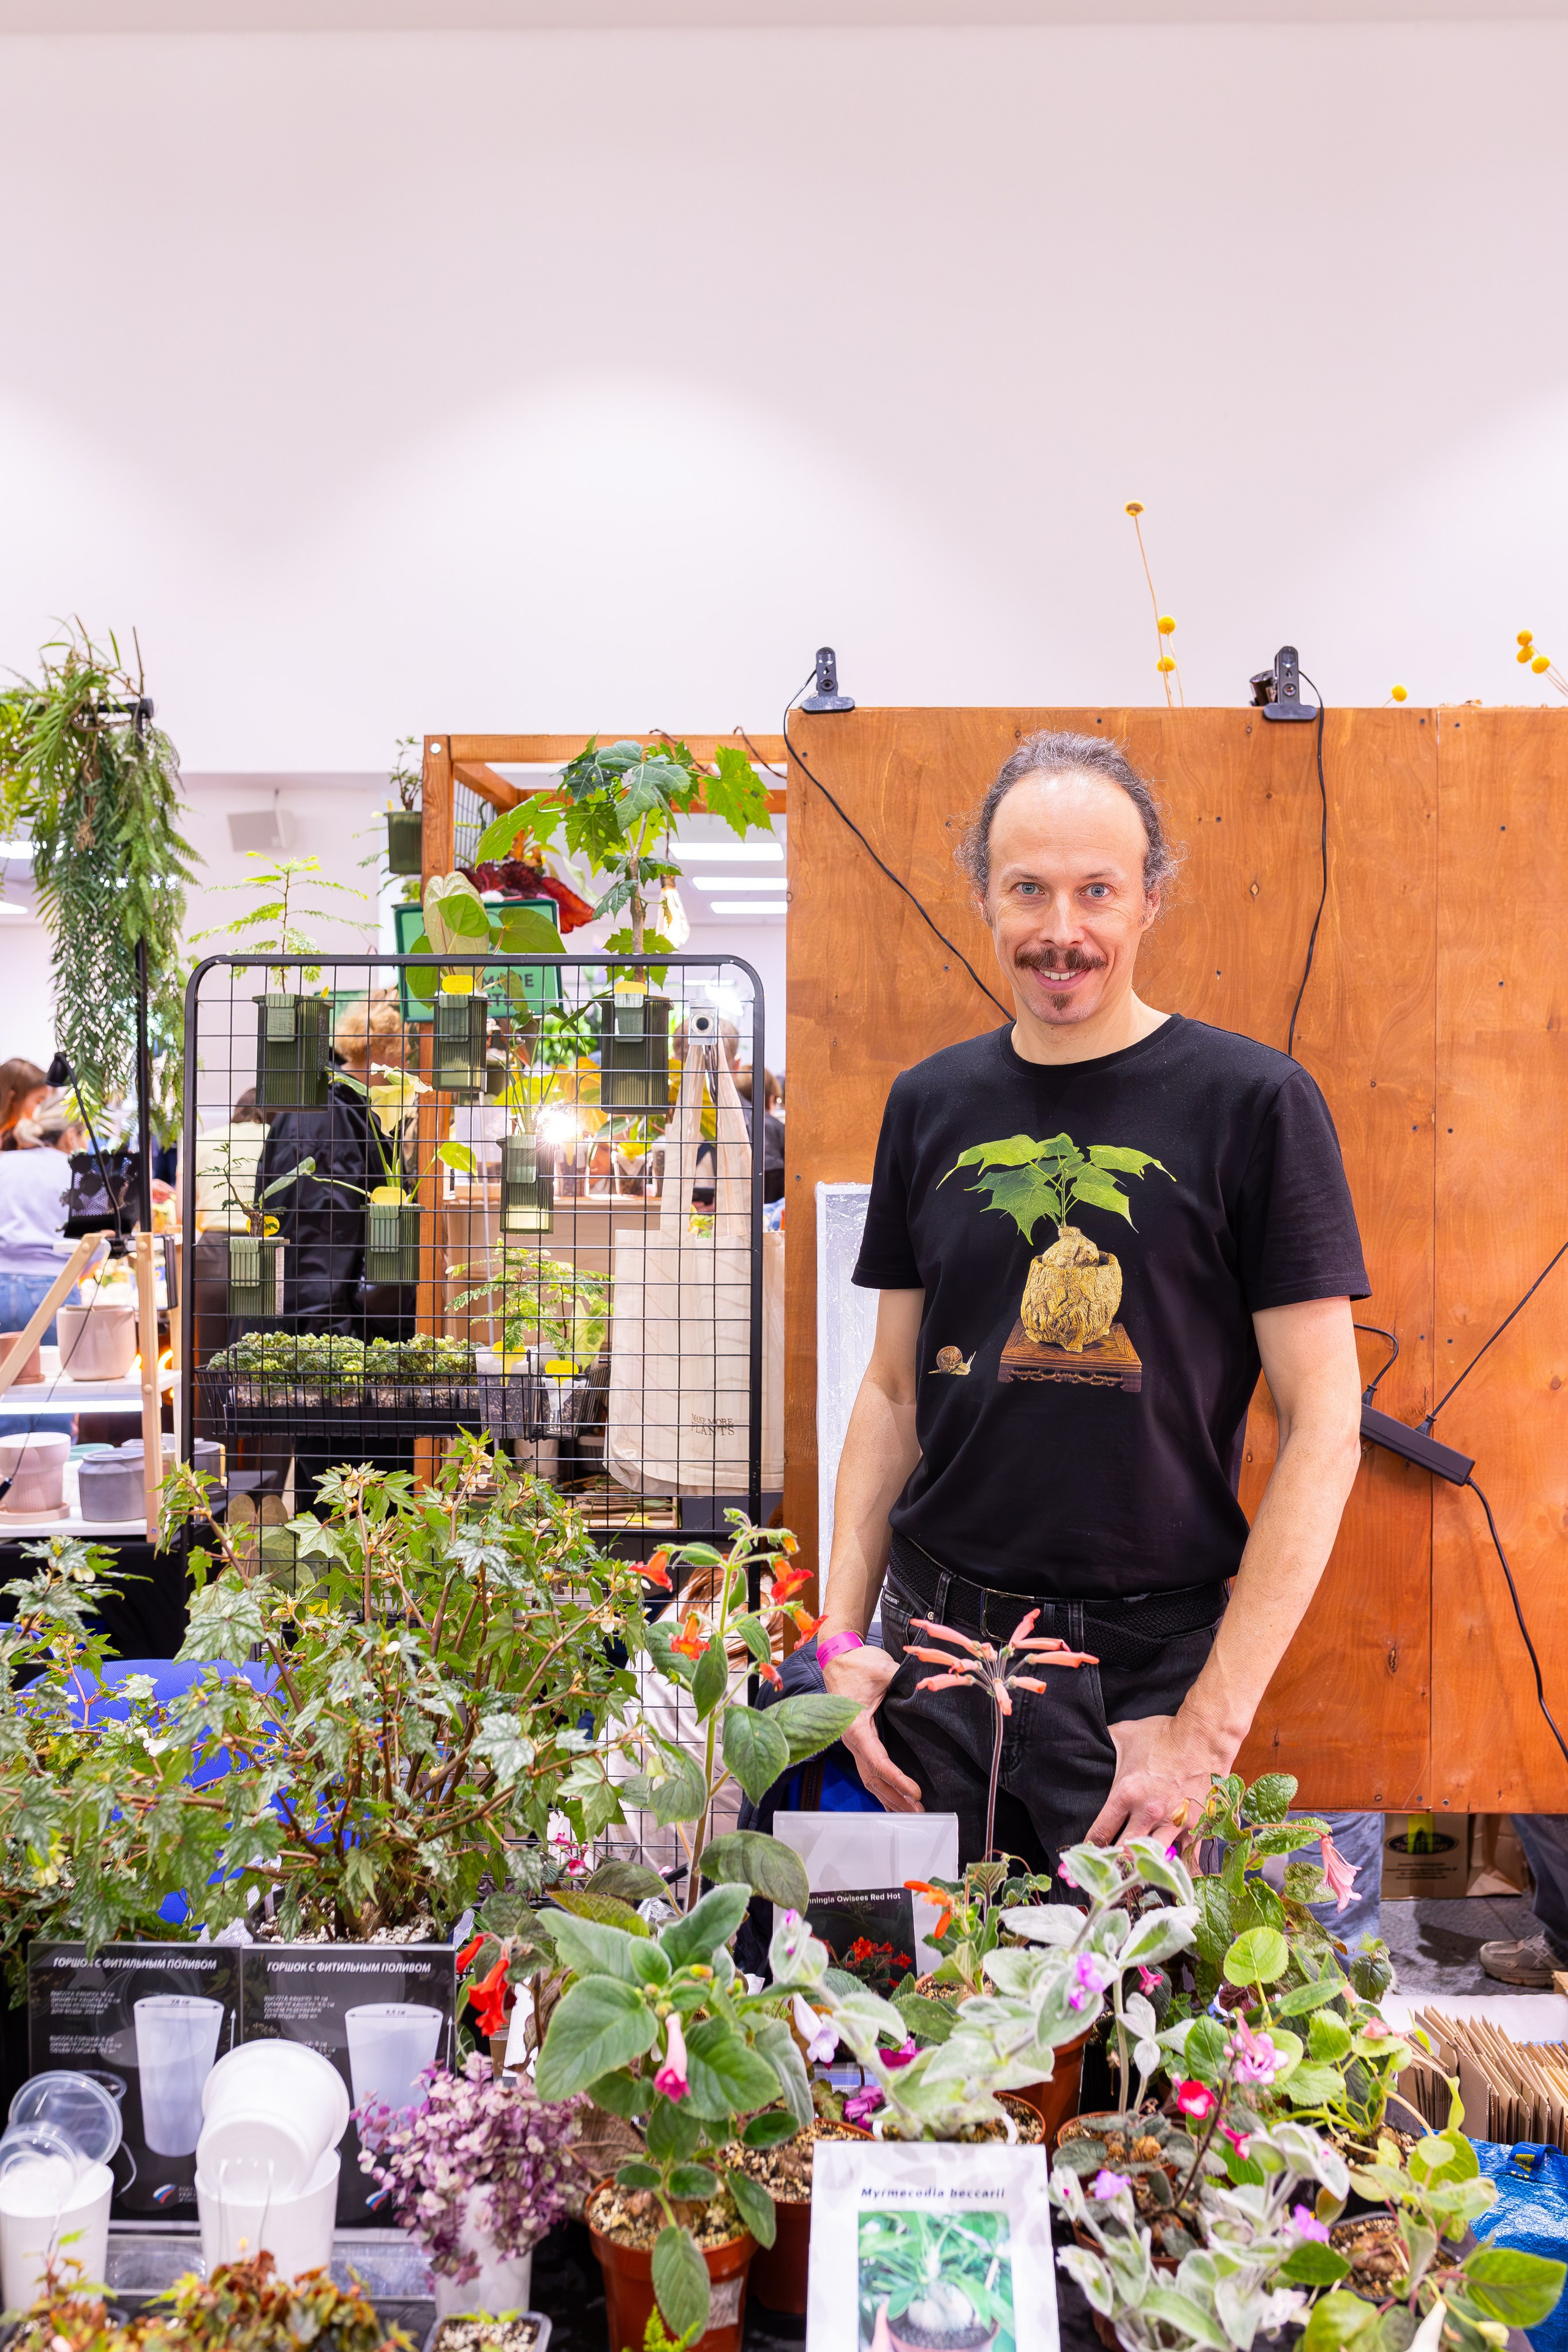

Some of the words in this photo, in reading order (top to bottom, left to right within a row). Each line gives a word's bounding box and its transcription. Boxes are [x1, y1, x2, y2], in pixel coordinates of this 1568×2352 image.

[691, 1414, 706, 1425] MAKE
[691, 1421, 735, 1436] PLANTS
[94, 1958, 102, 1968] С
[102, 1958, 166, 1969] ФИТИЛЬНЫМ
[167, 1959, 217, 1970] ПОЛИВОМ
[266, 1961, 308, 1972] ГОРШОК
[308, 1962, 316, 1972] С
[316, 1962, 380, 1973] ФИТИЛЬНЫМ
[381, 1962, 431, 1973] ПОЛИВОМ
[861, 2187, 944, 2199] Myrmecodia
[950, 2187, 1005, 2199] beccarii
